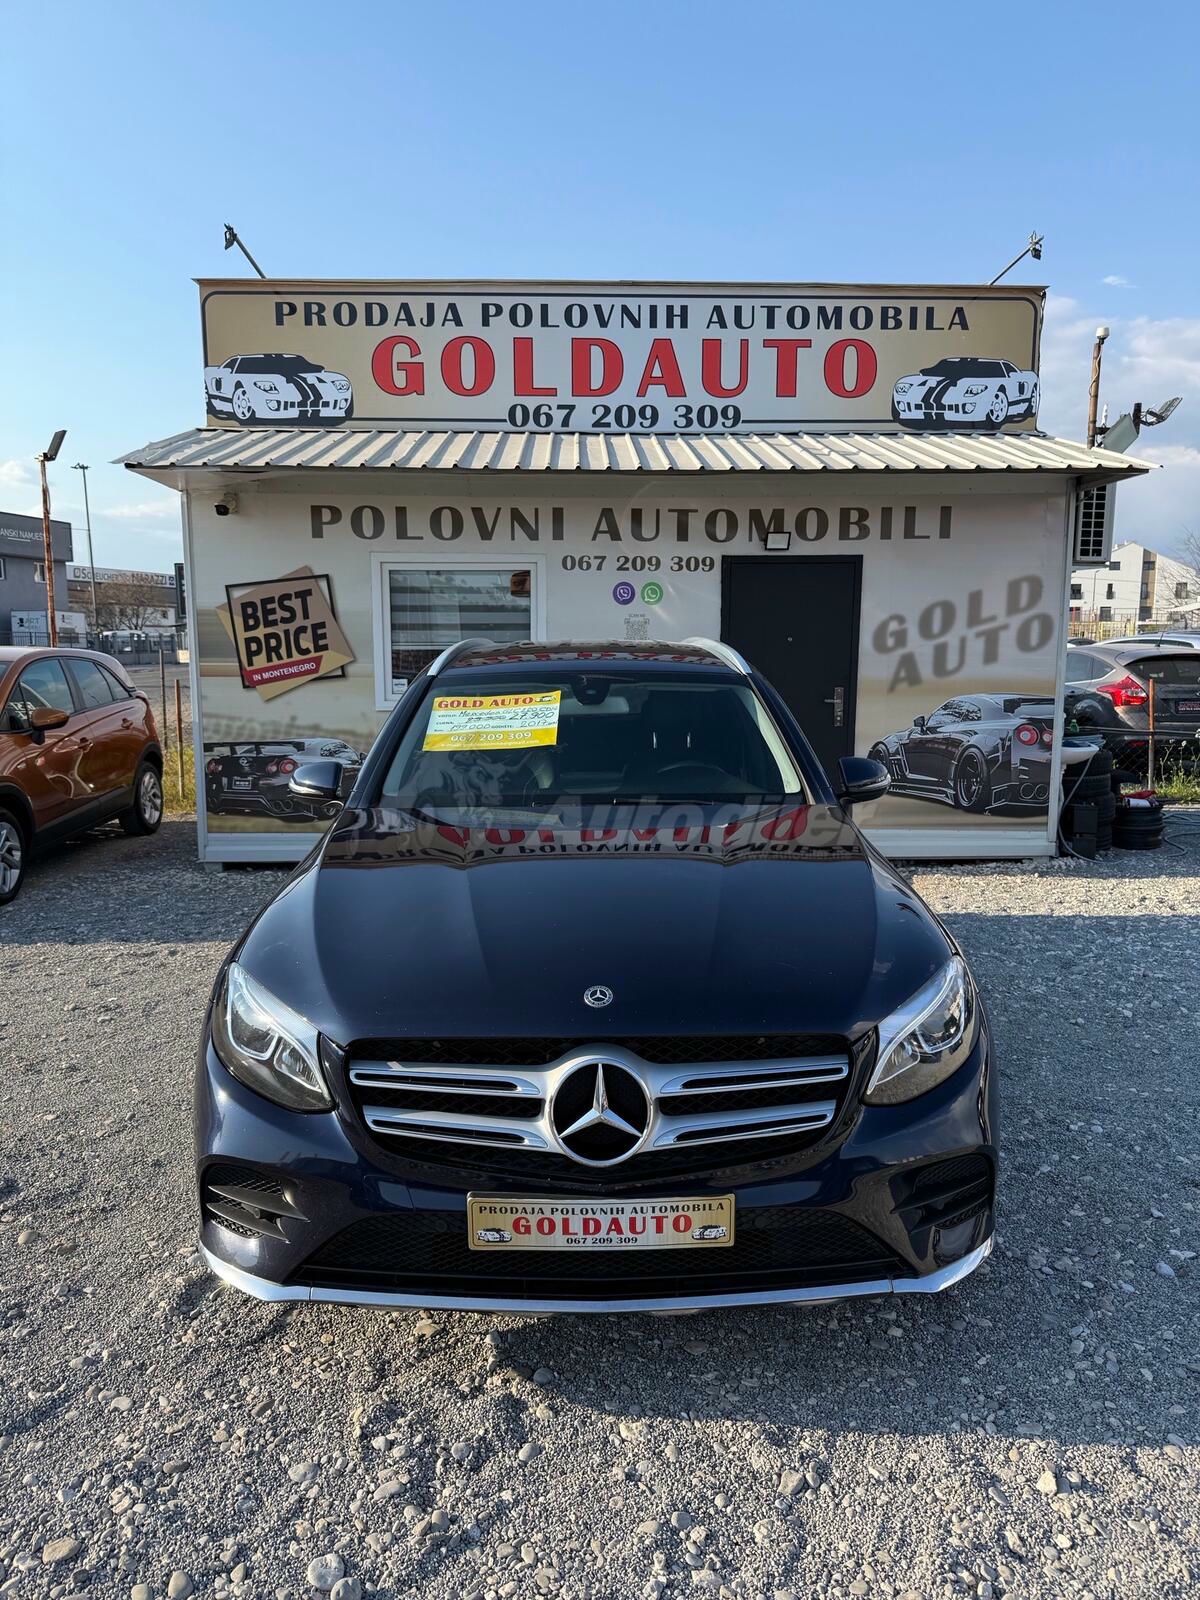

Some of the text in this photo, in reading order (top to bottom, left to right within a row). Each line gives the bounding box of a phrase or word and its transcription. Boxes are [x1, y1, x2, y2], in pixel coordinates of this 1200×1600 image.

[275, 301, 970, 331] PRODAJA POLOVNIH AUTOMOBILA
[371, 334, 878, 399] GOLDAUTO
[507, 403, 742, 429] 067 209 309
[310, 504, 953, 543] POLOVNI AUTOMOBILI
[561, 554, 715, 572] 067 209 309
[240, 588, 313, 633] BEST
[872, 574, 1044, 654] GOLD
[244, 621, 329, 667] PRICE
[887, 612, 1055, 693] AUTO
[253, 662, 317, 682] IN MONTENEGRO
[438, 697, 534, 709] GOLD AUTO
[480, 732, 504, 741] 209
[508, 731, 532, 740] 309
[479, 1202, 725, 1216] PRODAJA POLOVNIH AUTOMOBILA
[512, 1214, 693, 1236] GOLDAUTO
[566, 1236, 638, 1245] 067 209 309
